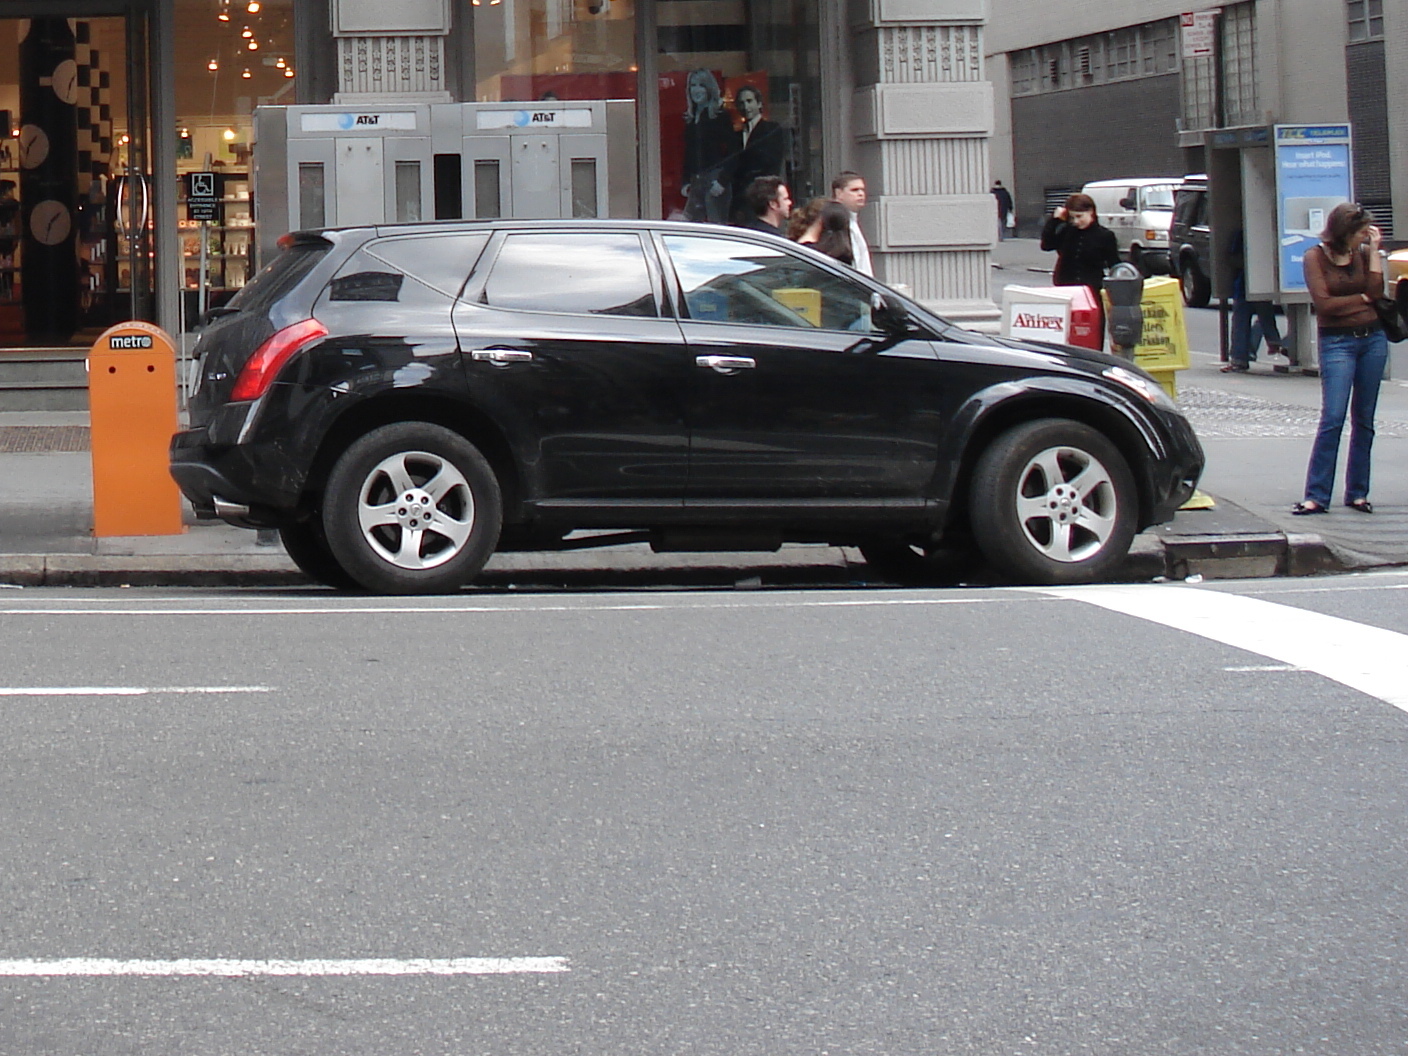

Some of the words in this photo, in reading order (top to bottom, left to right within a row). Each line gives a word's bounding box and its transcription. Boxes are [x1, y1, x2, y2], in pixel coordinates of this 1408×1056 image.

[356, 115, 380, 126] AT&T
[532, 112, 556, 123] AT&T
[111, 336, 152, 349] metro
